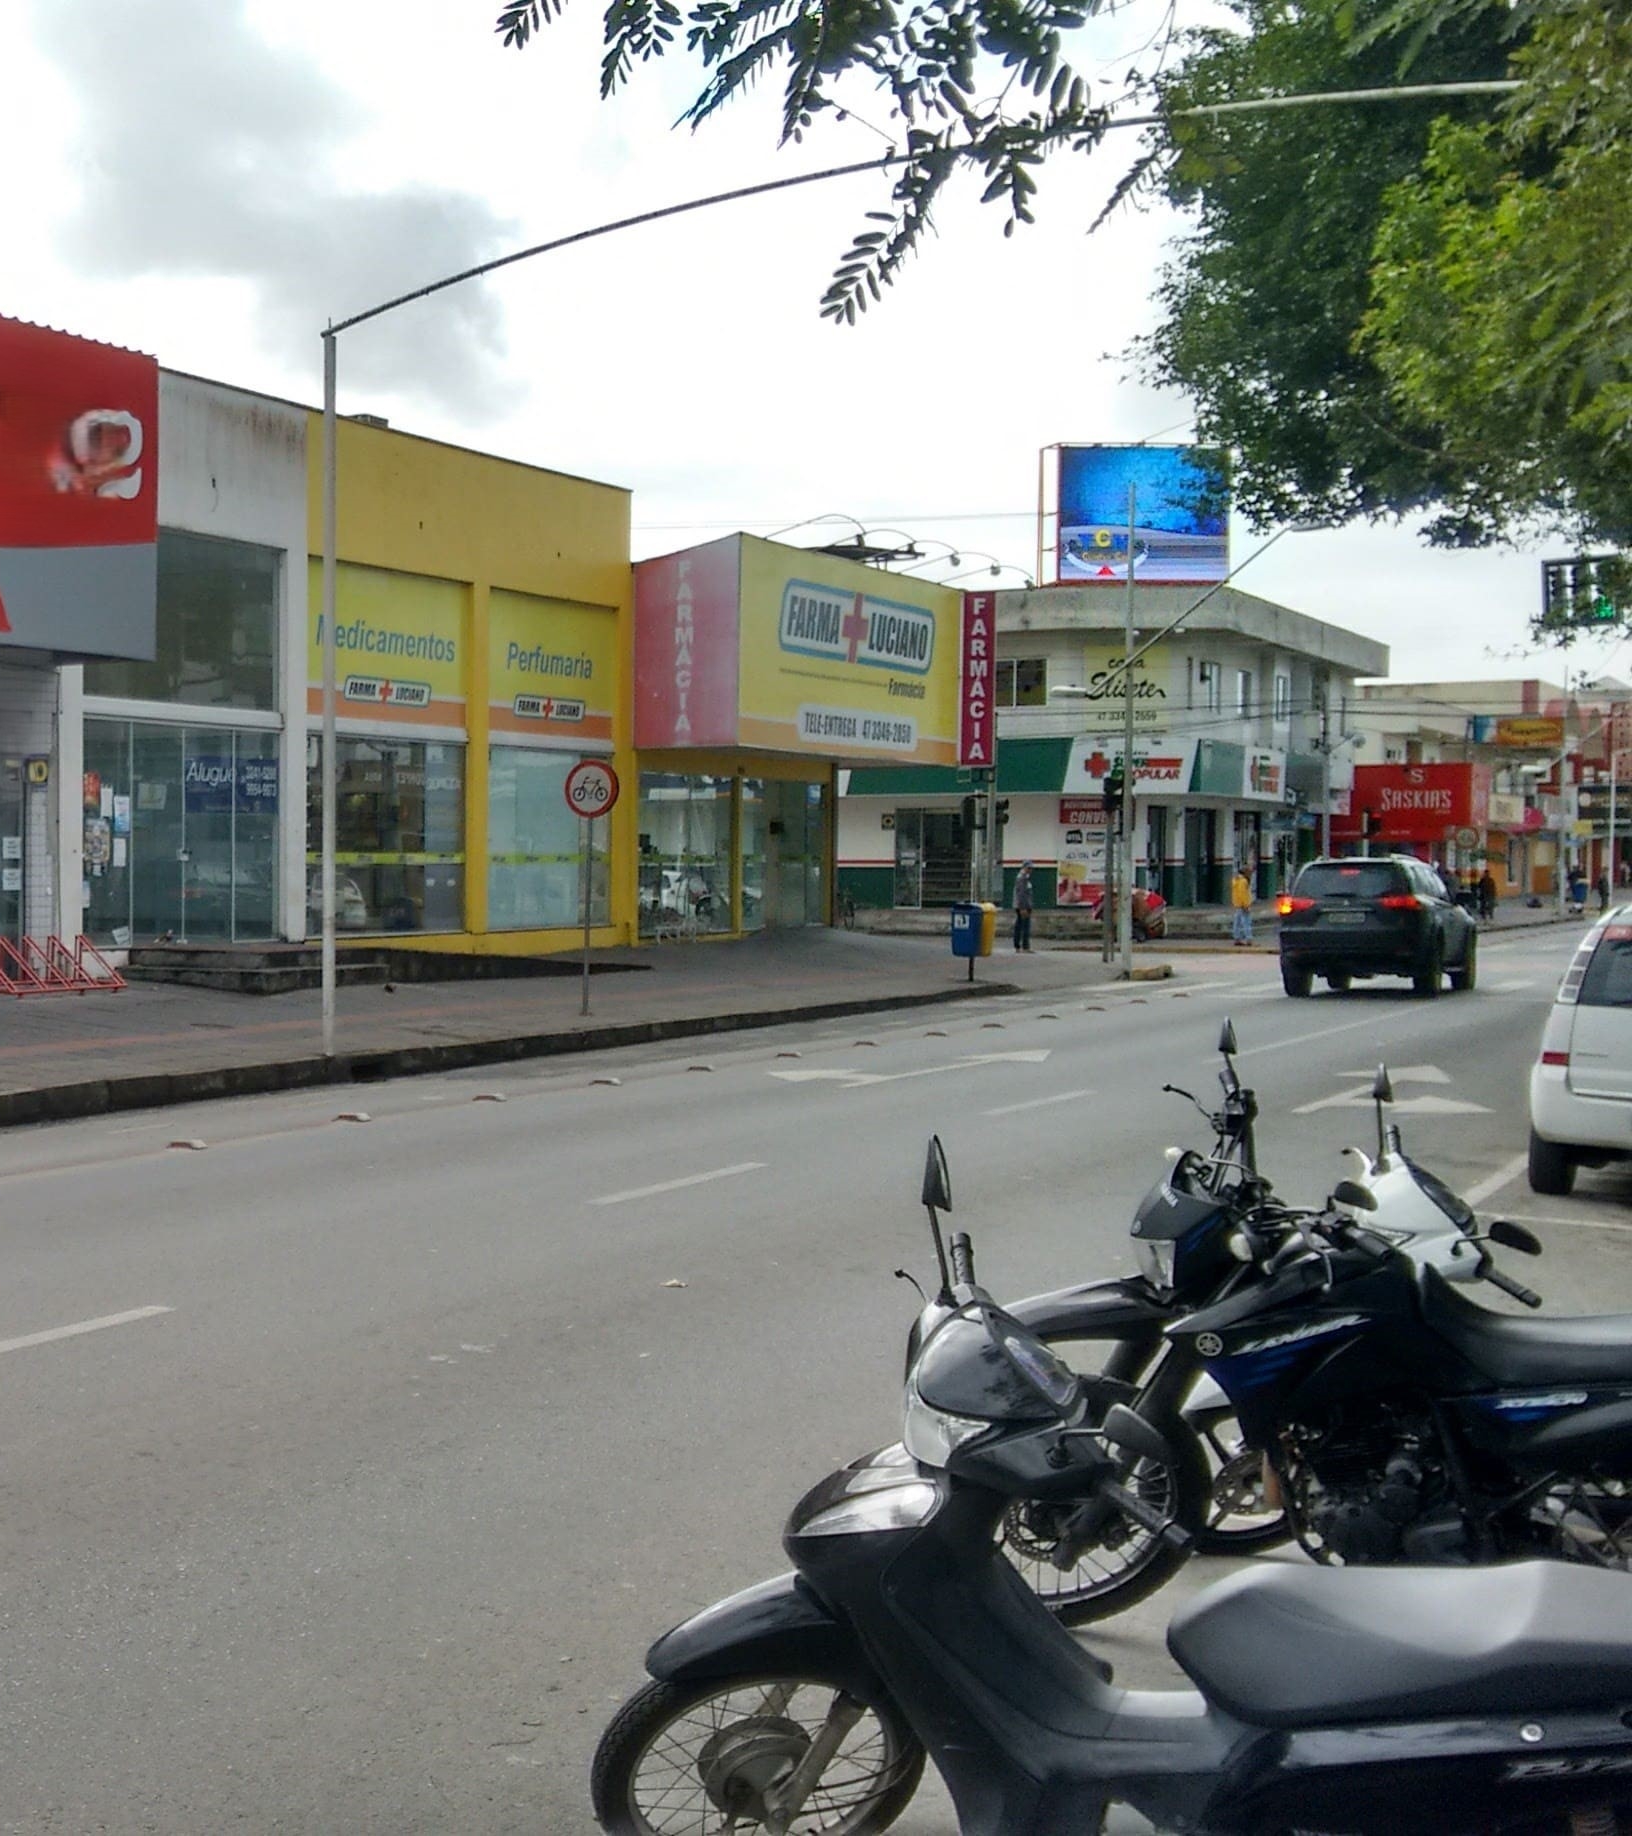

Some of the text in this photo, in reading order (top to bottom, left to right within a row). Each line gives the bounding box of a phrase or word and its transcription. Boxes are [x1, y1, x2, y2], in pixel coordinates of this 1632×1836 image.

[787, 596, 928, 661] FARMA LUCIANO
[507, 642, 592, 680] Perfumaria
[1108, 657, 1145, 669] caa
[349, 681, 424, 702] FARMA LUCIANO
[518, 699, 580, 718] FARMA LUCIANO
[805, 712, 856, 737] TELE-ENTREGA
[1128, 768, 1181, 780] OPULAR
